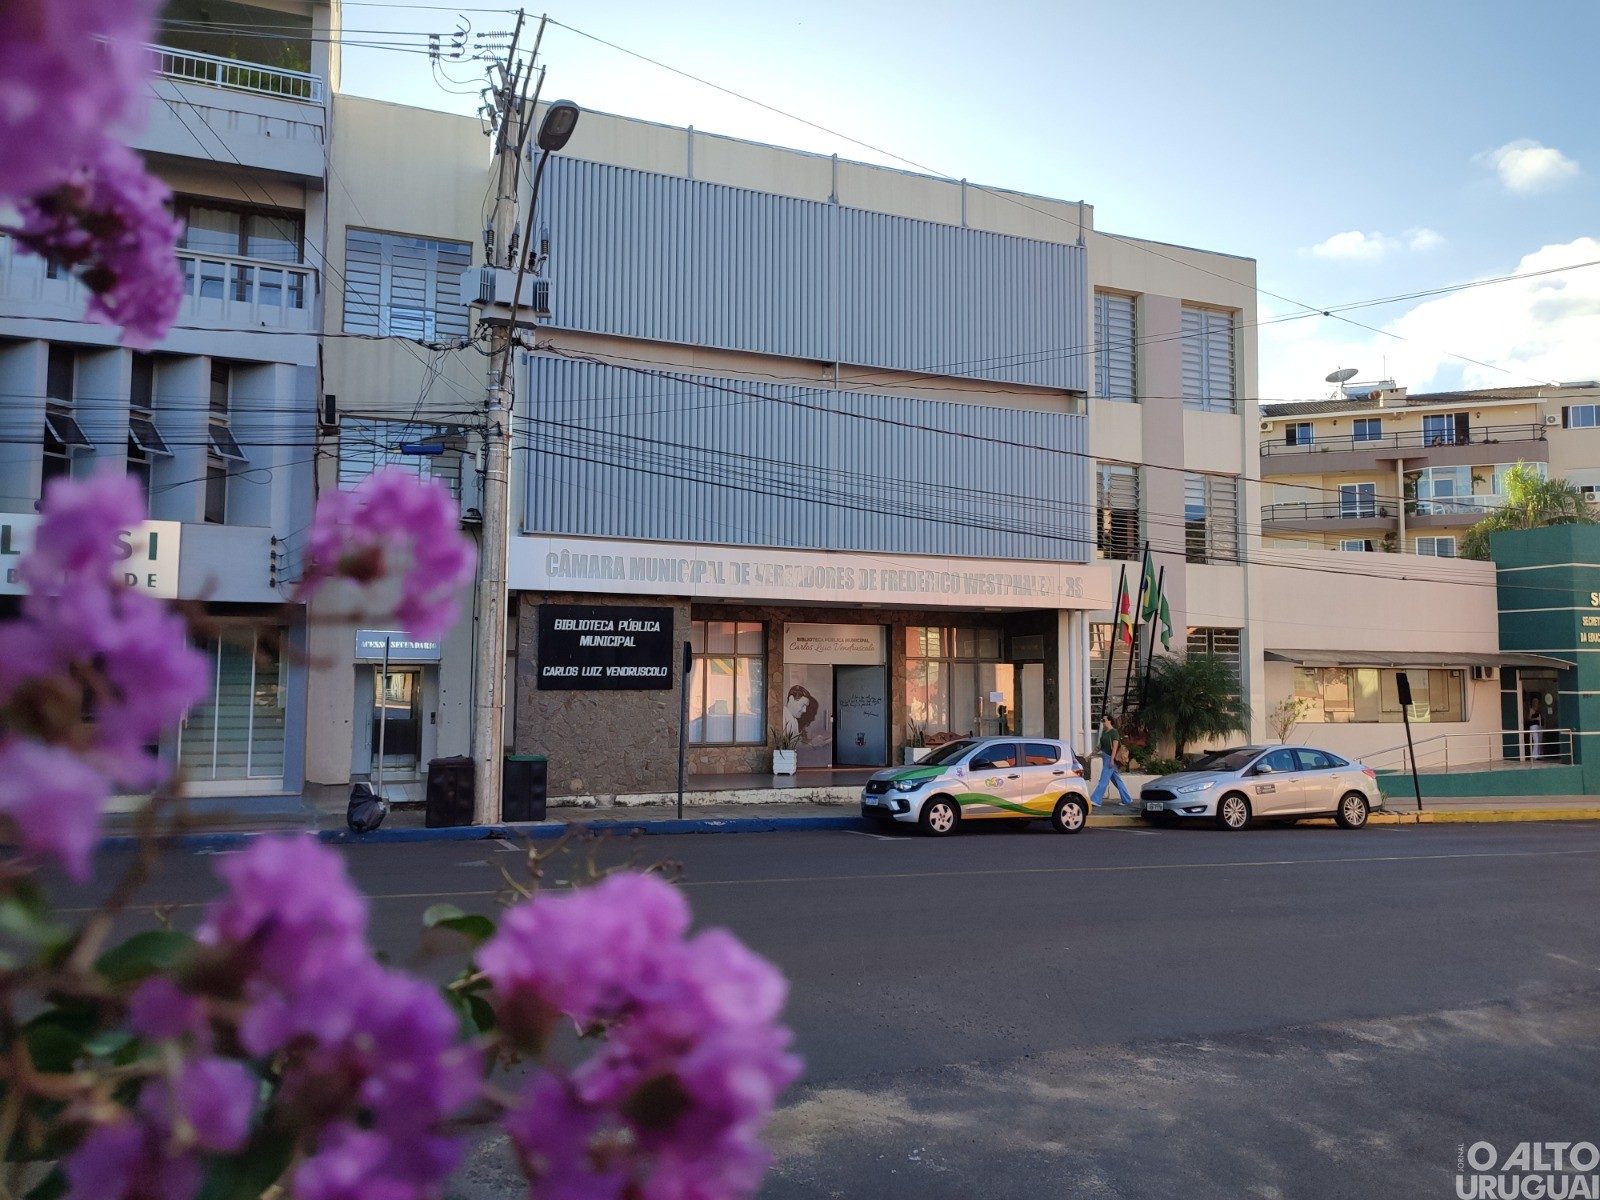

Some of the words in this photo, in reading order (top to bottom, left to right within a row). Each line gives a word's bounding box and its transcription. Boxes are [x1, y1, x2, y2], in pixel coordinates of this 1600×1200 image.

[545, 549, 625, 580] CÂMARA
[629, 556, 726, 584] MUNICIPAL
[729, 561, 751, 585] DE
[858, 568, 877, 591] DE
[880, 569, 960, 594] FREDERICO
[1065, 576, 1084, 598] RS
[554, 619, 614, 631] BIBLIOTECA
[618, 618, 660, 632] PÚBLICA
[580, 635, 636, 647] MUNICIPAL
[789, 642, 813, 651] Carlos
[543, 666, 578, 677] CARLOS
[582, 666, 602, 676] LUIZ
[606, 666, 668, 677] VENDRUSCOLO
